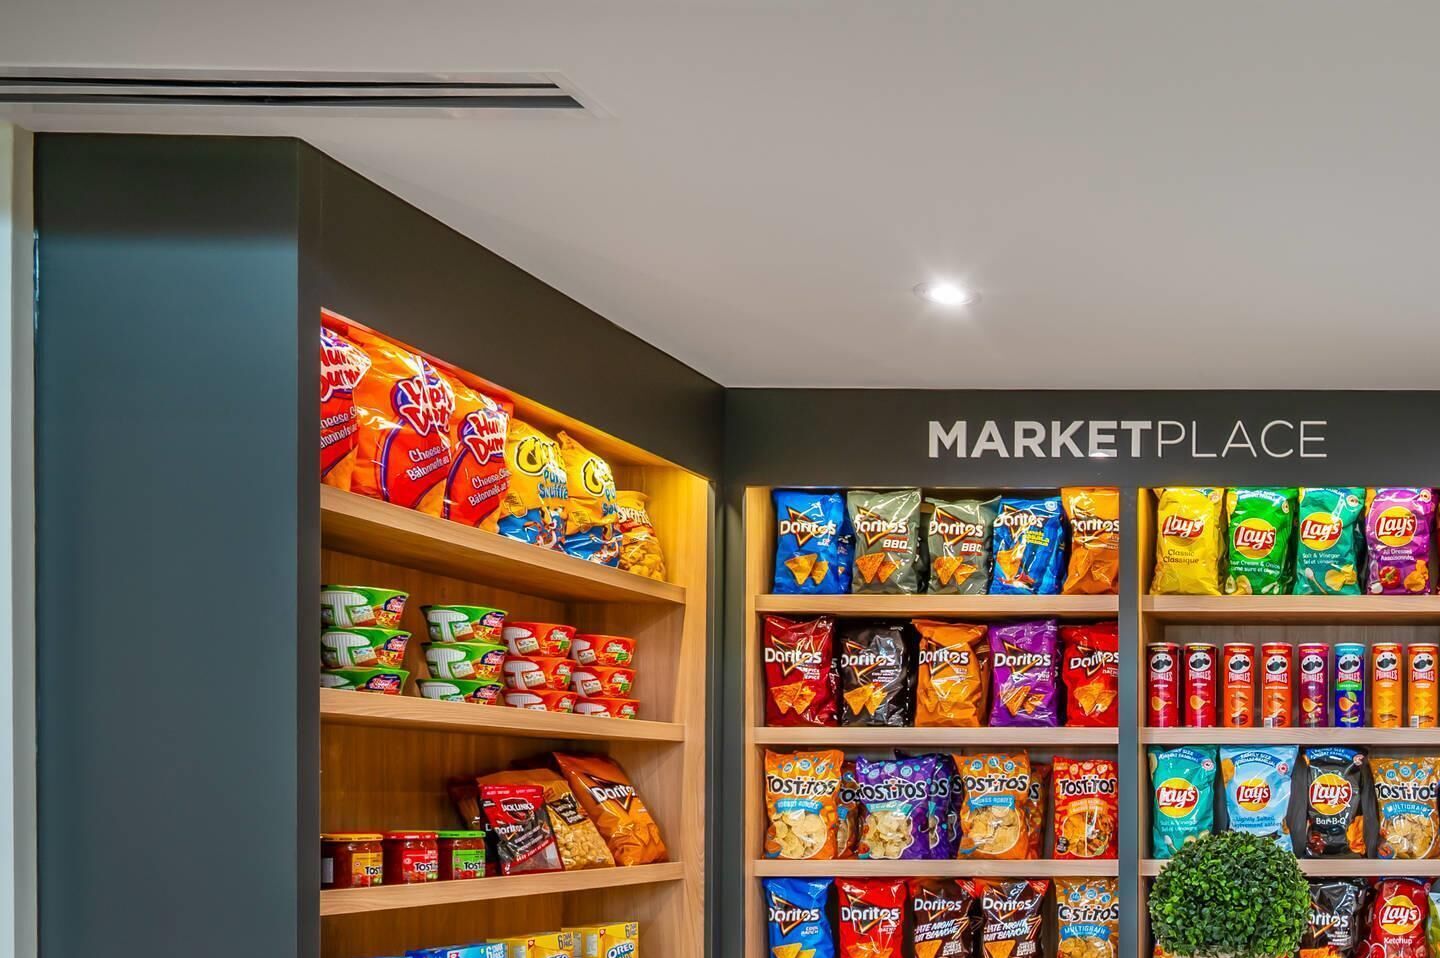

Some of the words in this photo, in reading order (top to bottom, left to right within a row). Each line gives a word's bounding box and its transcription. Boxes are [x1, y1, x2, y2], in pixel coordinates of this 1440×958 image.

[928, 420, 1327, 458] MARKETPLACE
[780, 519, 837, 536] Doritos
[929, 520, 984, 537] Doritos
[993, 512, 1043, 528] Doritos
[1377, 516, 1415, 538] Lay's
[1236, 526, 1276, 550] Lay's
[1302, 520, 1341, 542] Lay's
[883, 538, 907, 549] BBQ
[765, 647, 822, 664] Doritos
[841, 653, 896, 668] Doritos
[919, 650, 969, 665] Doritos
[994, 653, 1051, 667] Doritos
[1070, 651, 1119, 670] Doritos
[1159, 786, 1197, 808] Lay's
[1237, 785, 1271, 803] Lay's
[1311, 783, 1350, 807] Lay's
[914, 898, 962, 911] Doritos
[982, 897, 1032, 912] Doritos
[768, 907, 820, 922] Doritos
[841, 906, 899, 922] Doritos
[1307, 911, 1349, 928] oritos
[1382, 904, 1419, 927] Lay's
[1384, 937, 1412, 945] Ketchup
[607, 943, 635, 958] OREO
